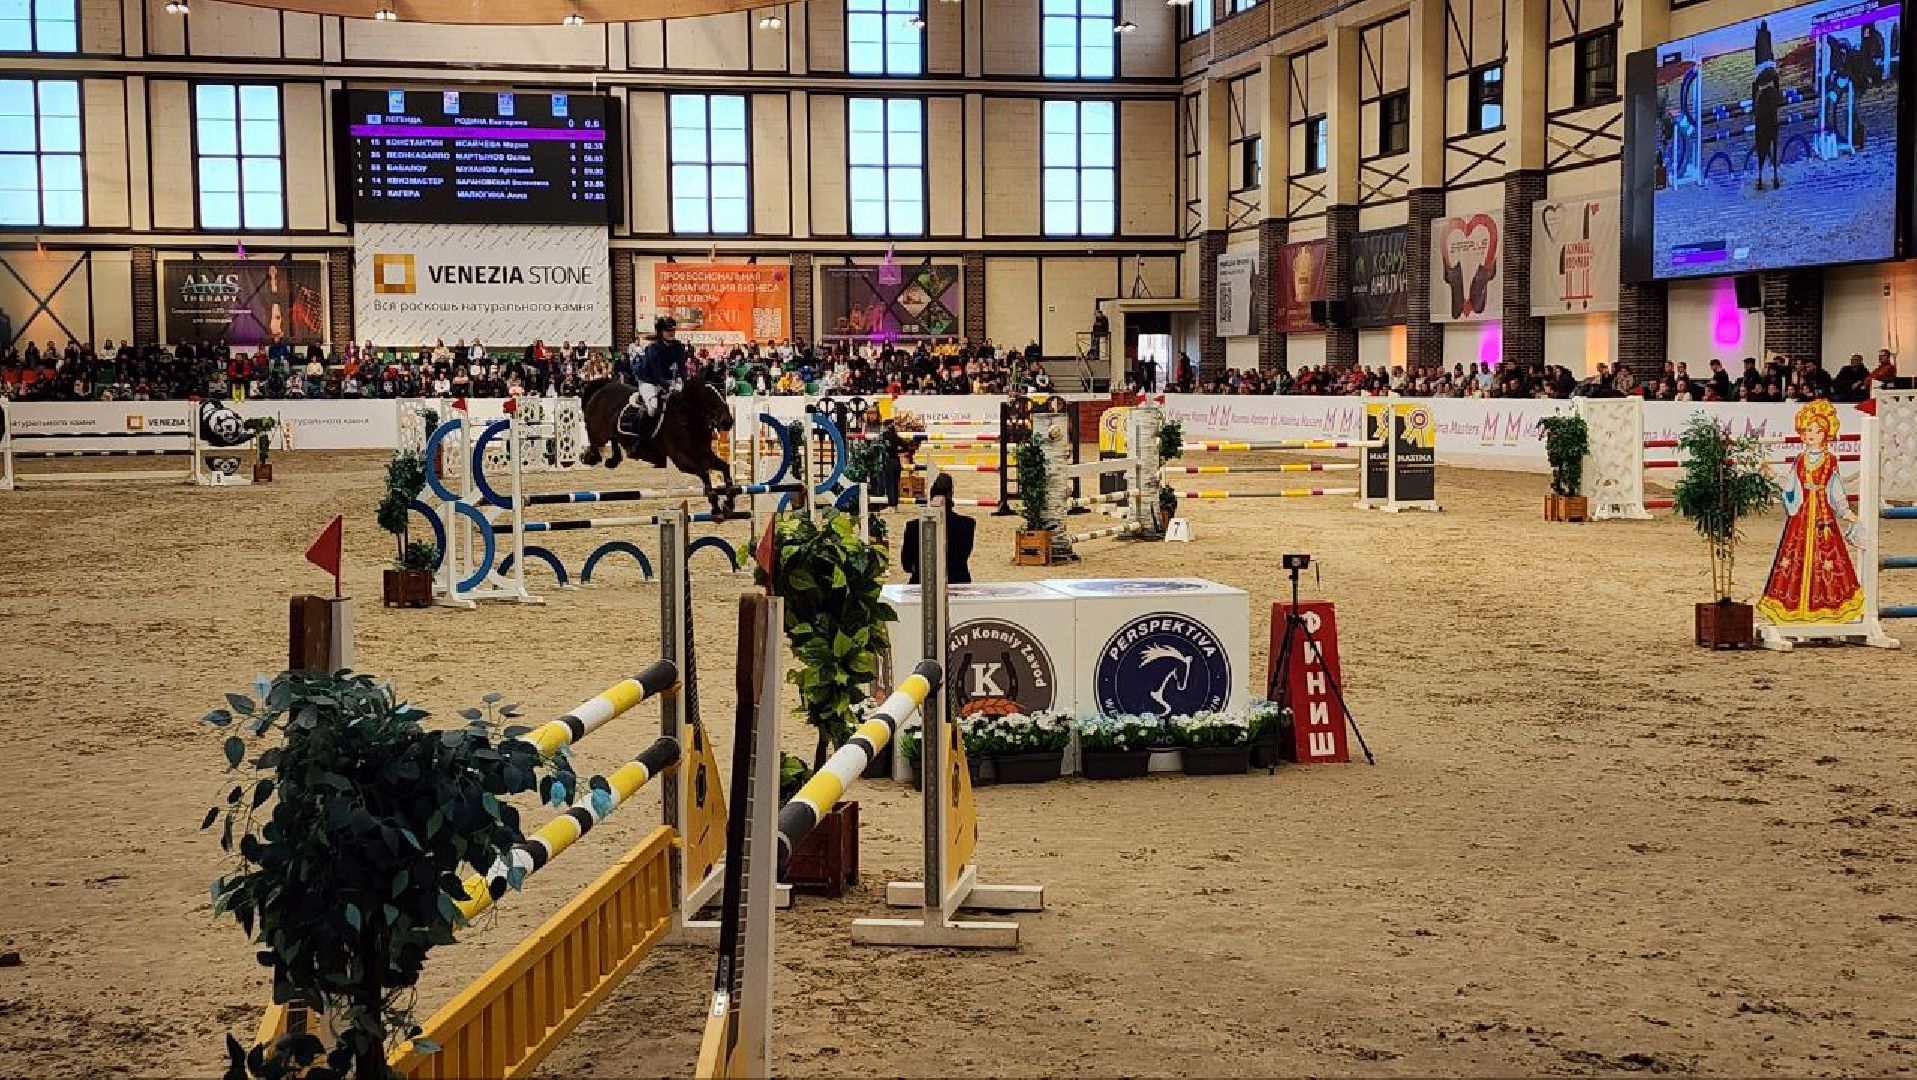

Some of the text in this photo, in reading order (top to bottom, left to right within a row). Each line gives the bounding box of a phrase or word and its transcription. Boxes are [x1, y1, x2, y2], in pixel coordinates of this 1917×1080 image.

[385, 138, 444, 147] КОНСТАНТИН
[428, 265, 594, 285] VENEZIA STONE
[659, 271, 761, 281] ПРОФЕССИОНАЛЬНАЯ
[180, 274, 242, 294] AMS
[183, 294, 237, 302] THERAPY
[373, 299, 594, 314] Вся роскошь натурального камня
[148, 418, 186, 427] VENEZIA
[1397, 454, 1432, 462] MAXIMA
[1173, 521, 1181, 537] 7
[1108, 618, 1217, 661] PERSPEKTIVA
[971, 626, 1022, 649] Konniy
[1020, 643, 1047, 688] Zavod
[970, 662, 1005, 697] K
[1299, 610, 1336, 757] ФИНИШ
